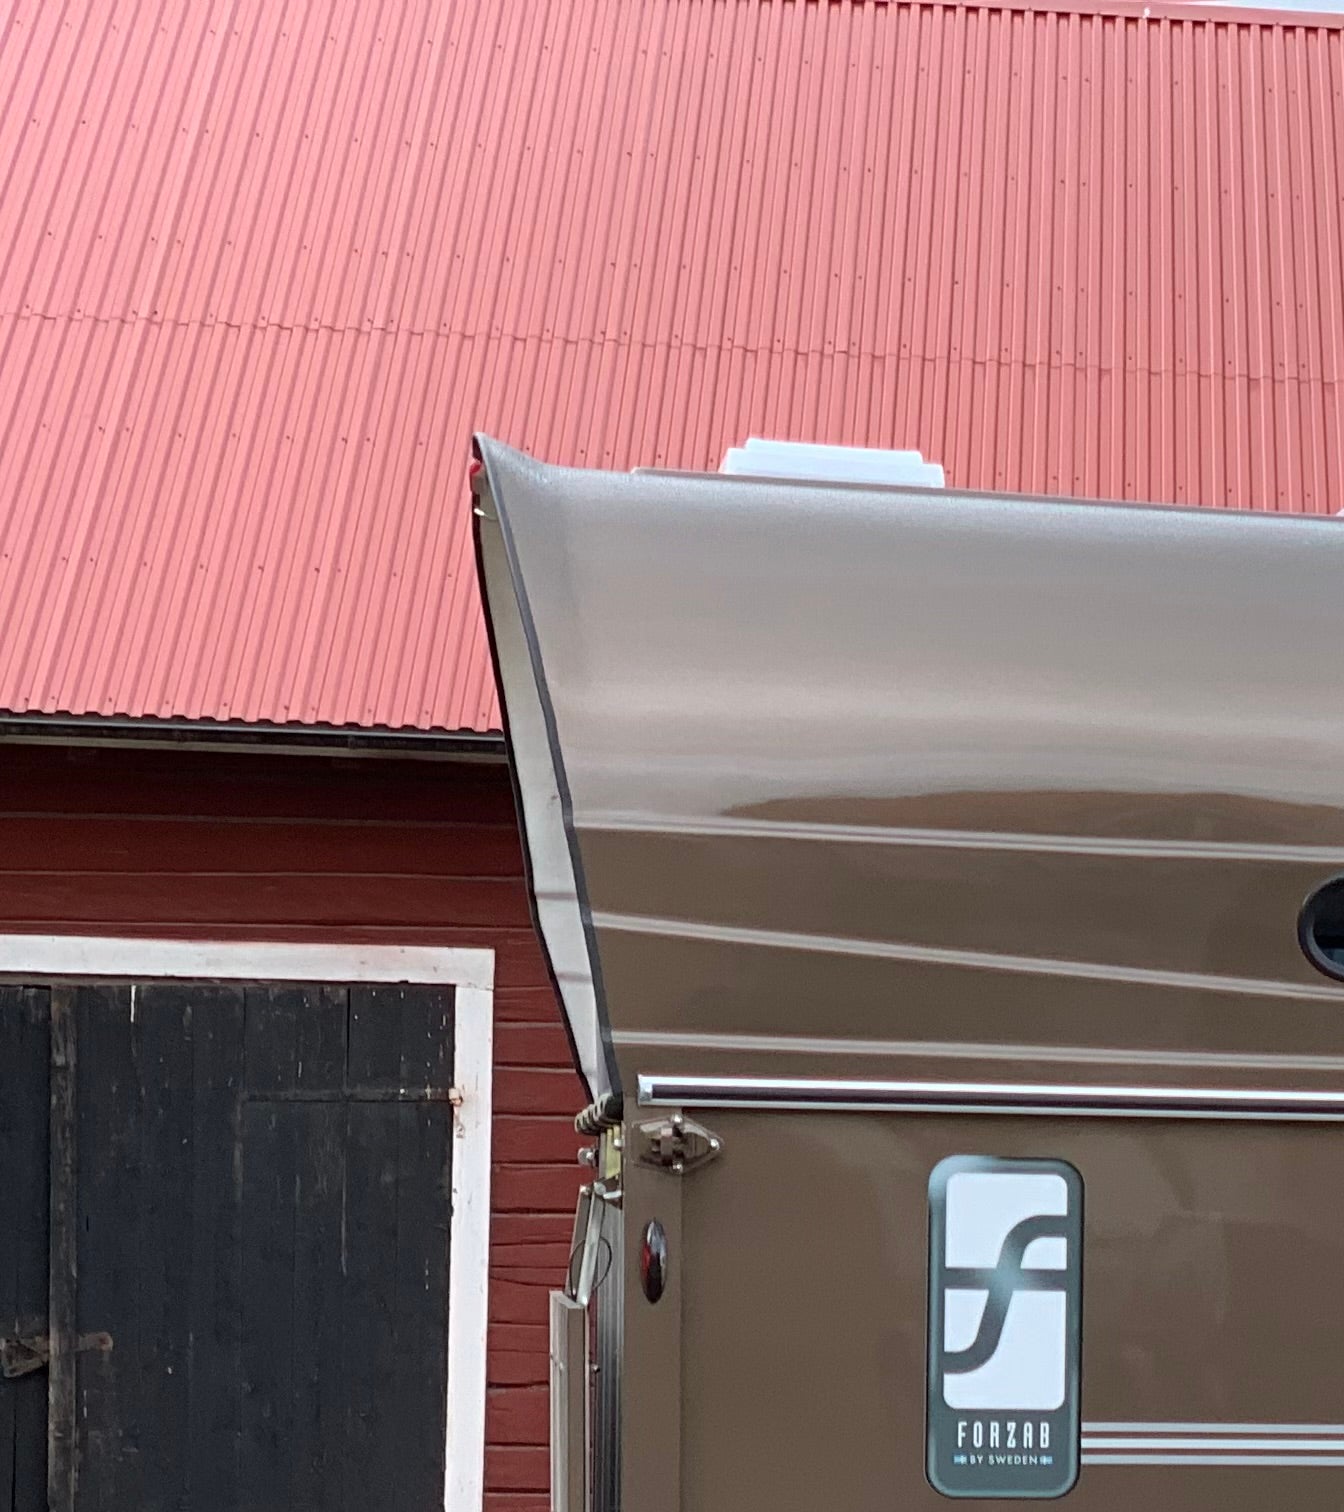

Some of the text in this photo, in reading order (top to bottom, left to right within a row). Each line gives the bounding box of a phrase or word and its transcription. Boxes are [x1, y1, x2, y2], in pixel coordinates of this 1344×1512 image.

[957, 1421, 1050, 1449] FORZAB
[969, 1455, 1038, 1465] BY SWEDEN
